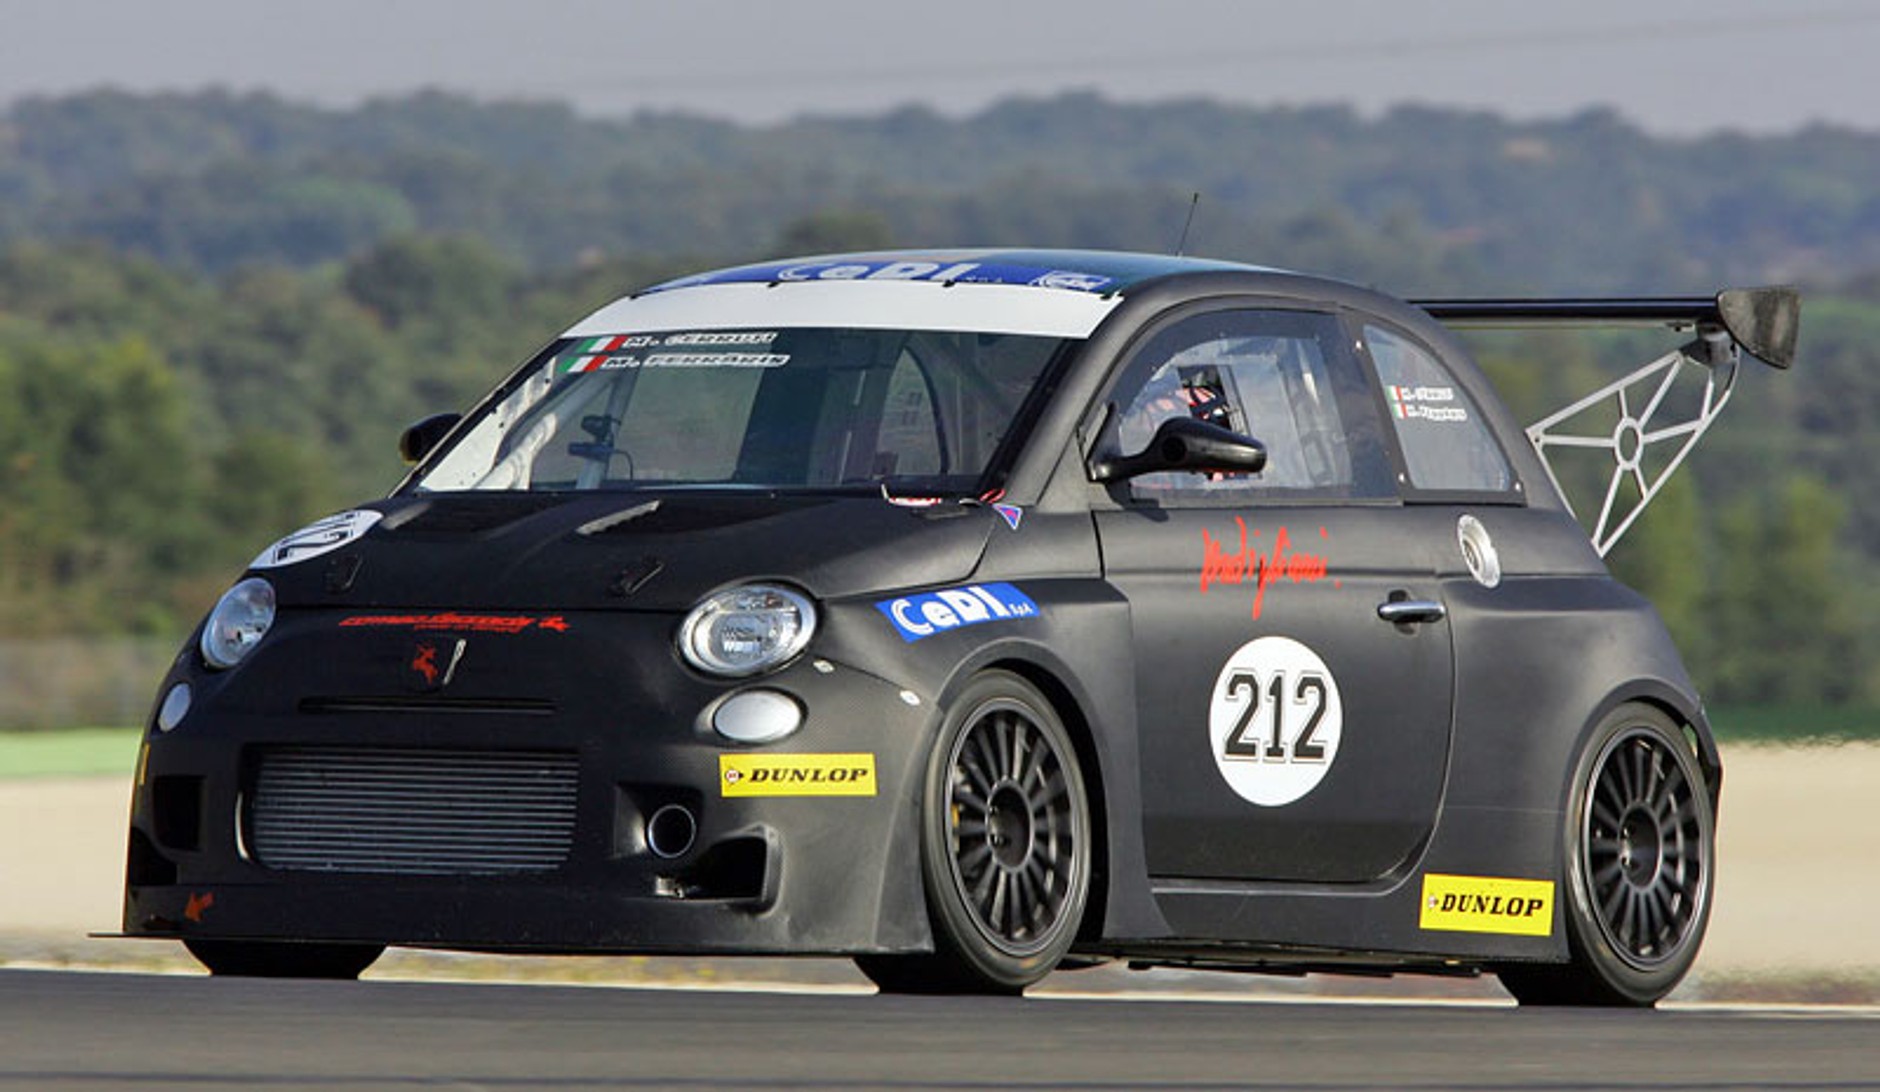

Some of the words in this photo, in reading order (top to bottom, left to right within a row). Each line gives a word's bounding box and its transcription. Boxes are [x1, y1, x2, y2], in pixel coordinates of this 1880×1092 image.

[890, 586, 1011, 635] CeDI
[1222, 667, 1328, 765] 212
[749, 768, 868, 783] DUNLOP
[1441, 893, 1544, 918] DUNLOP
